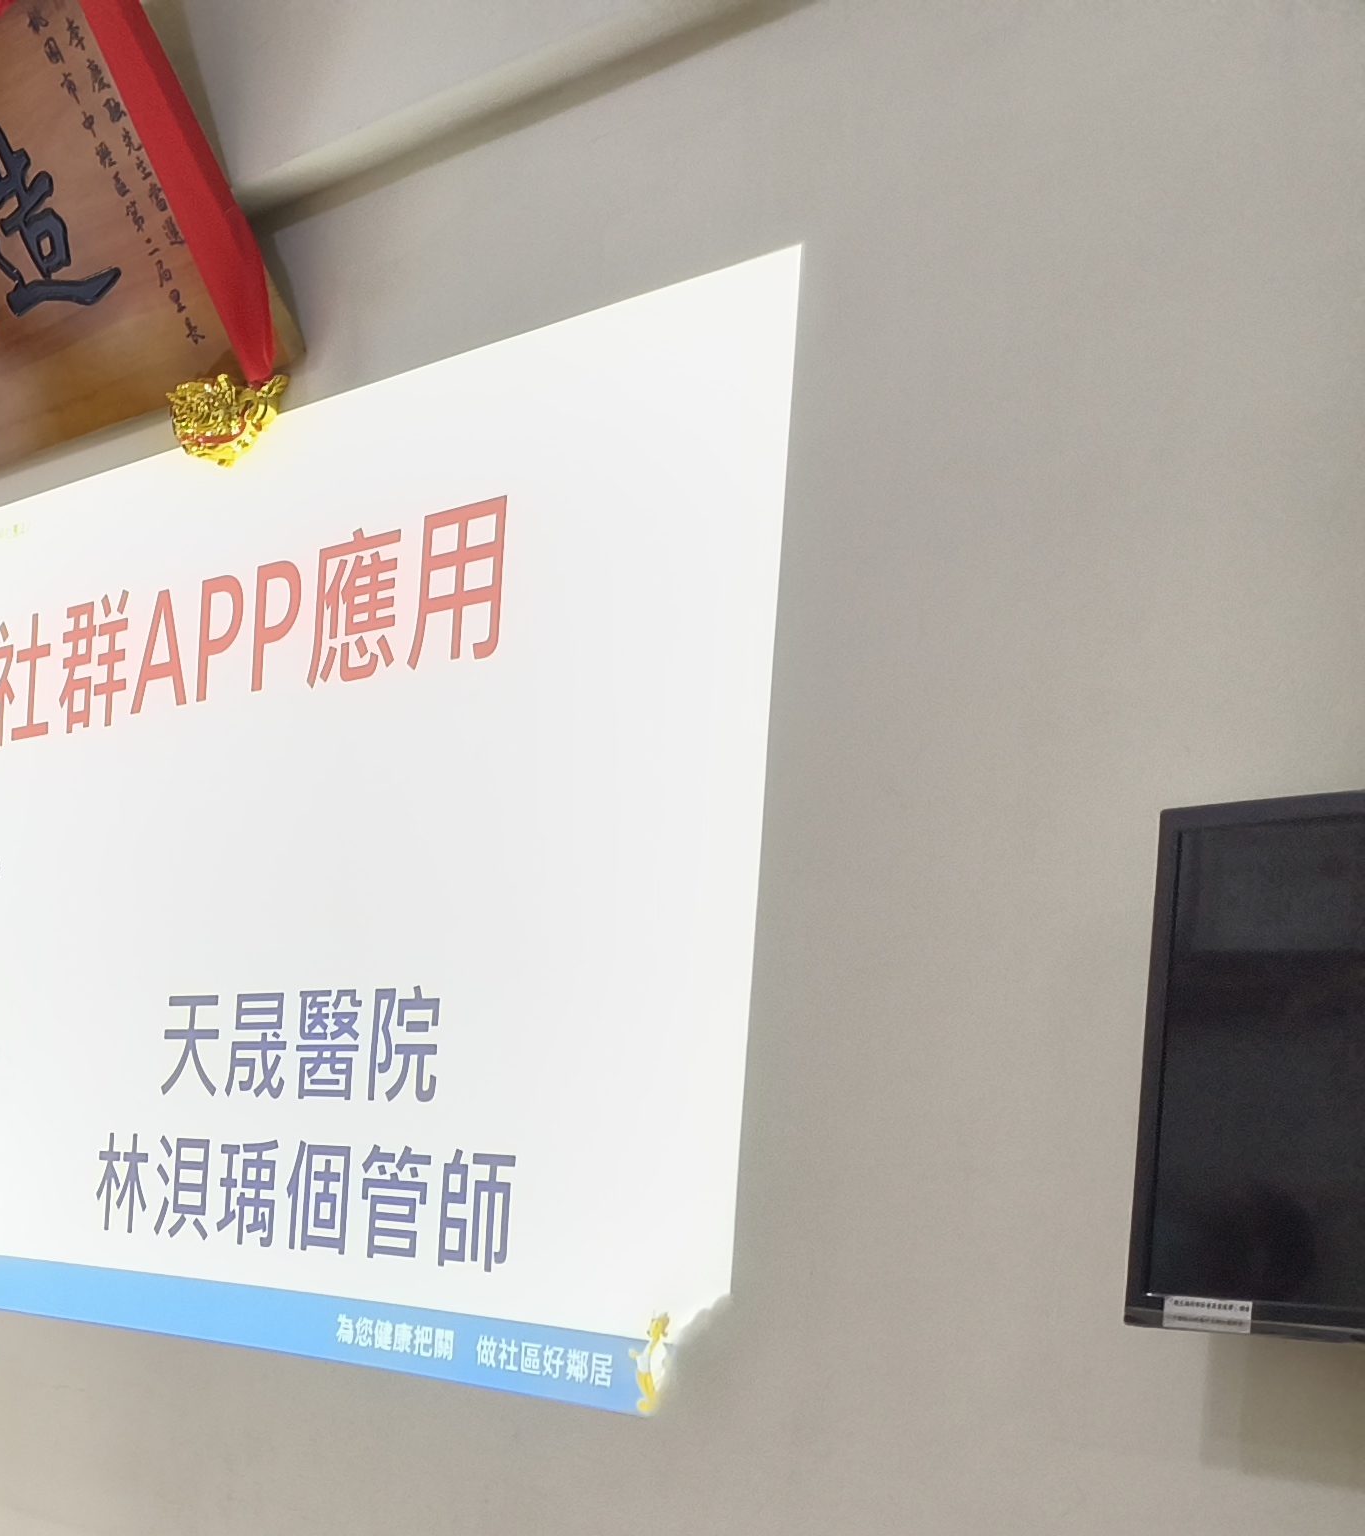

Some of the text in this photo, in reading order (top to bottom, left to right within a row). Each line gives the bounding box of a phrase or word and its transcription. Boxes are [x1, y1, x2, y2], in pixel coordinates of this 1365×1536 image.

[160, 985, 441, 1103] 天晟醫院
[95, 1132, 517, 1273] 林浿瑀個管師
[335, 1313, 614, 1388] 為您健康把關 做社區好鄰居
